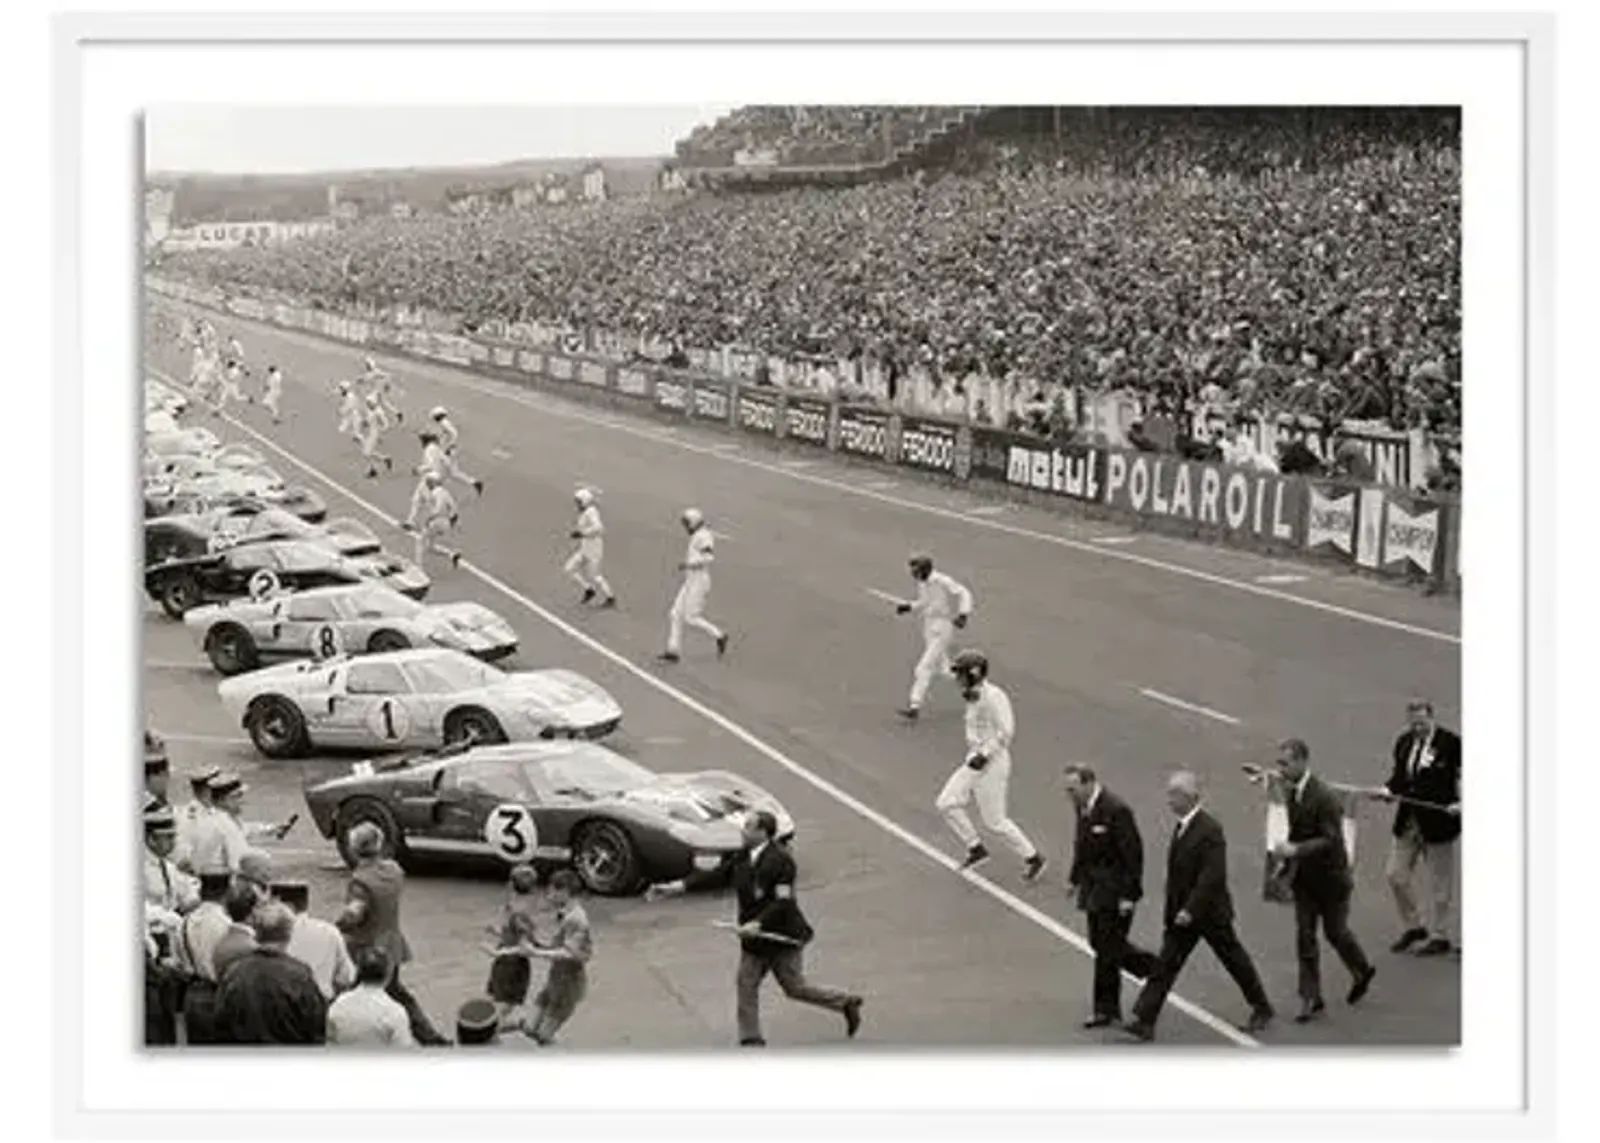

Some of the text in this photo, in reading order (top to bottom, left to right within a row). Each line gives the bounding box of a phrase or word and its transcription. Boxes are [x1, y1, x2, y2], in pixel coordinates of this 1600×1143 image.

[1007, 446, 1098, 498] motul
[1105, 453, 1291, 539] POLAROIL
[320, 626, 336, 659] 8
[381, 701, 398, 739] 1
[498, 810, 527, 855] 3
